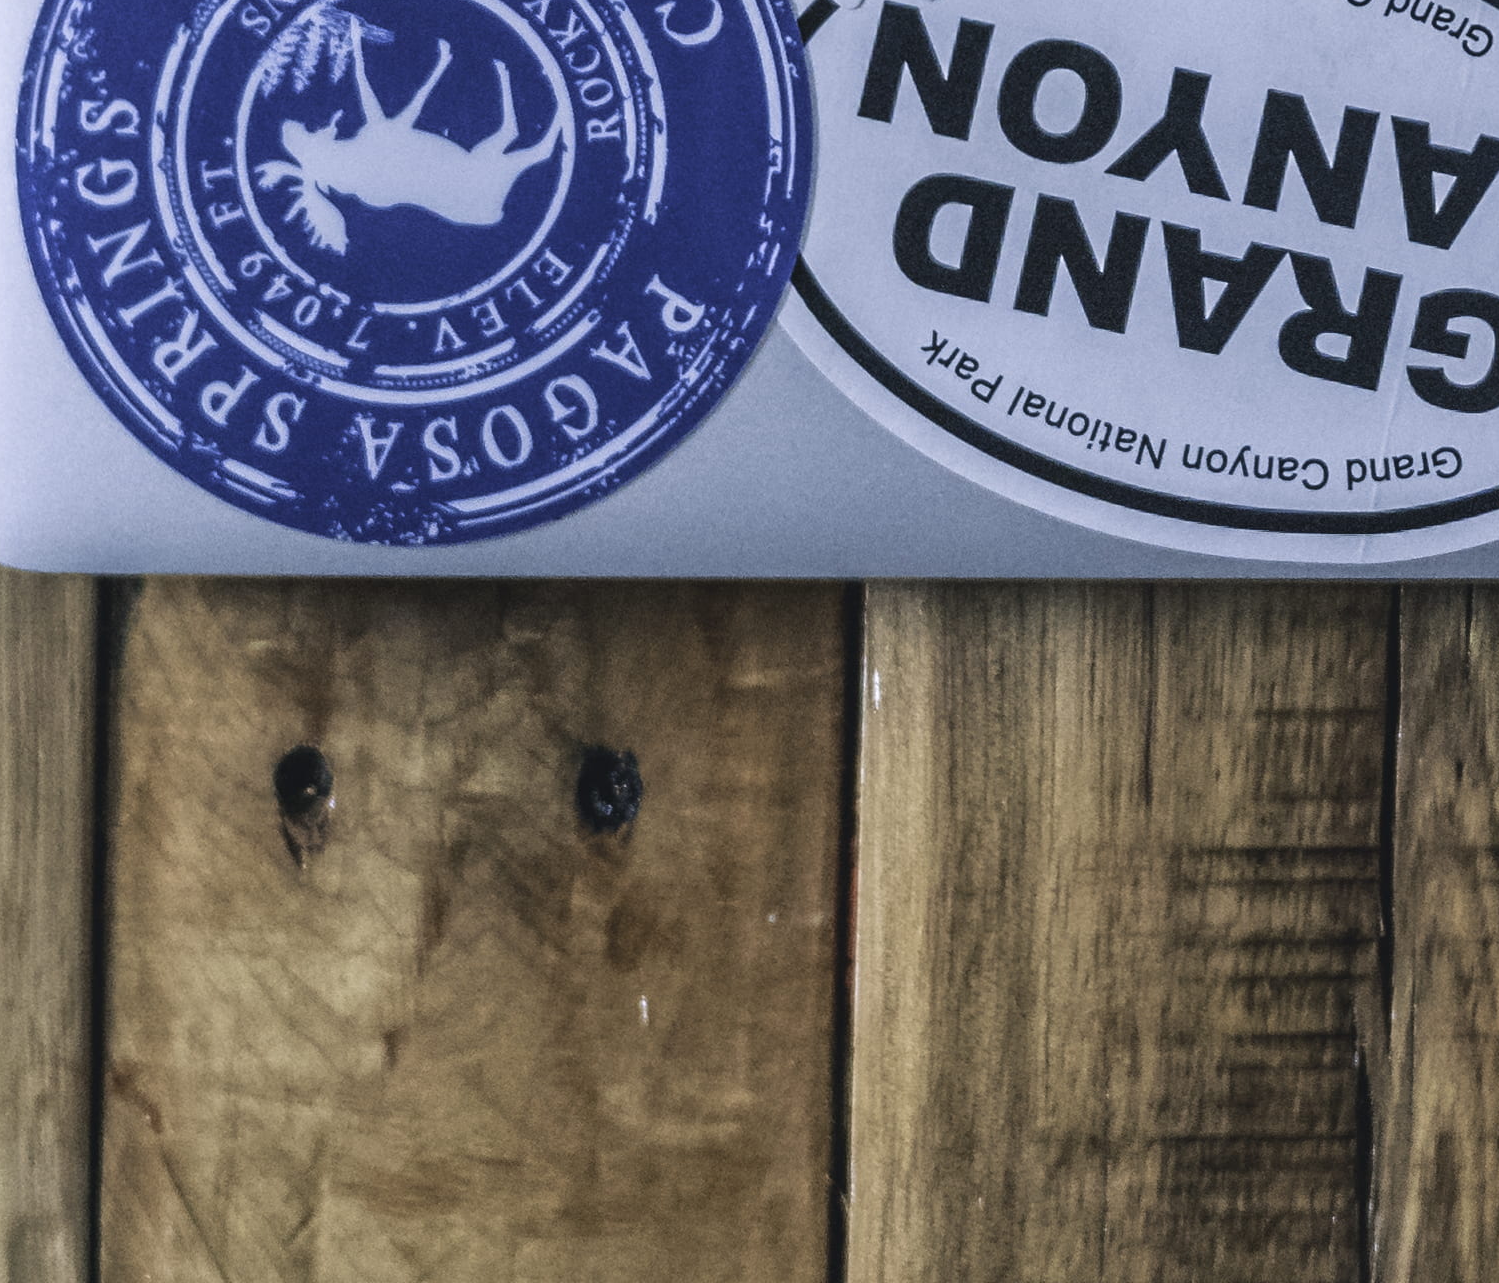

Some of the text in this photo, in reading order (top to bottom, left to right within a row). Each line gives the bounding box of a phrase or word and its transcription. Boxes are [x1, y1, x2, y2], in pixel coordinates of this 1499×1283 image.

[77, 95, 707, 482] PAGOSA SPRINGS
[407, 247, 574, 353] ELEV.
[921, 330, 1463, 491] Grand Canyon National Park
